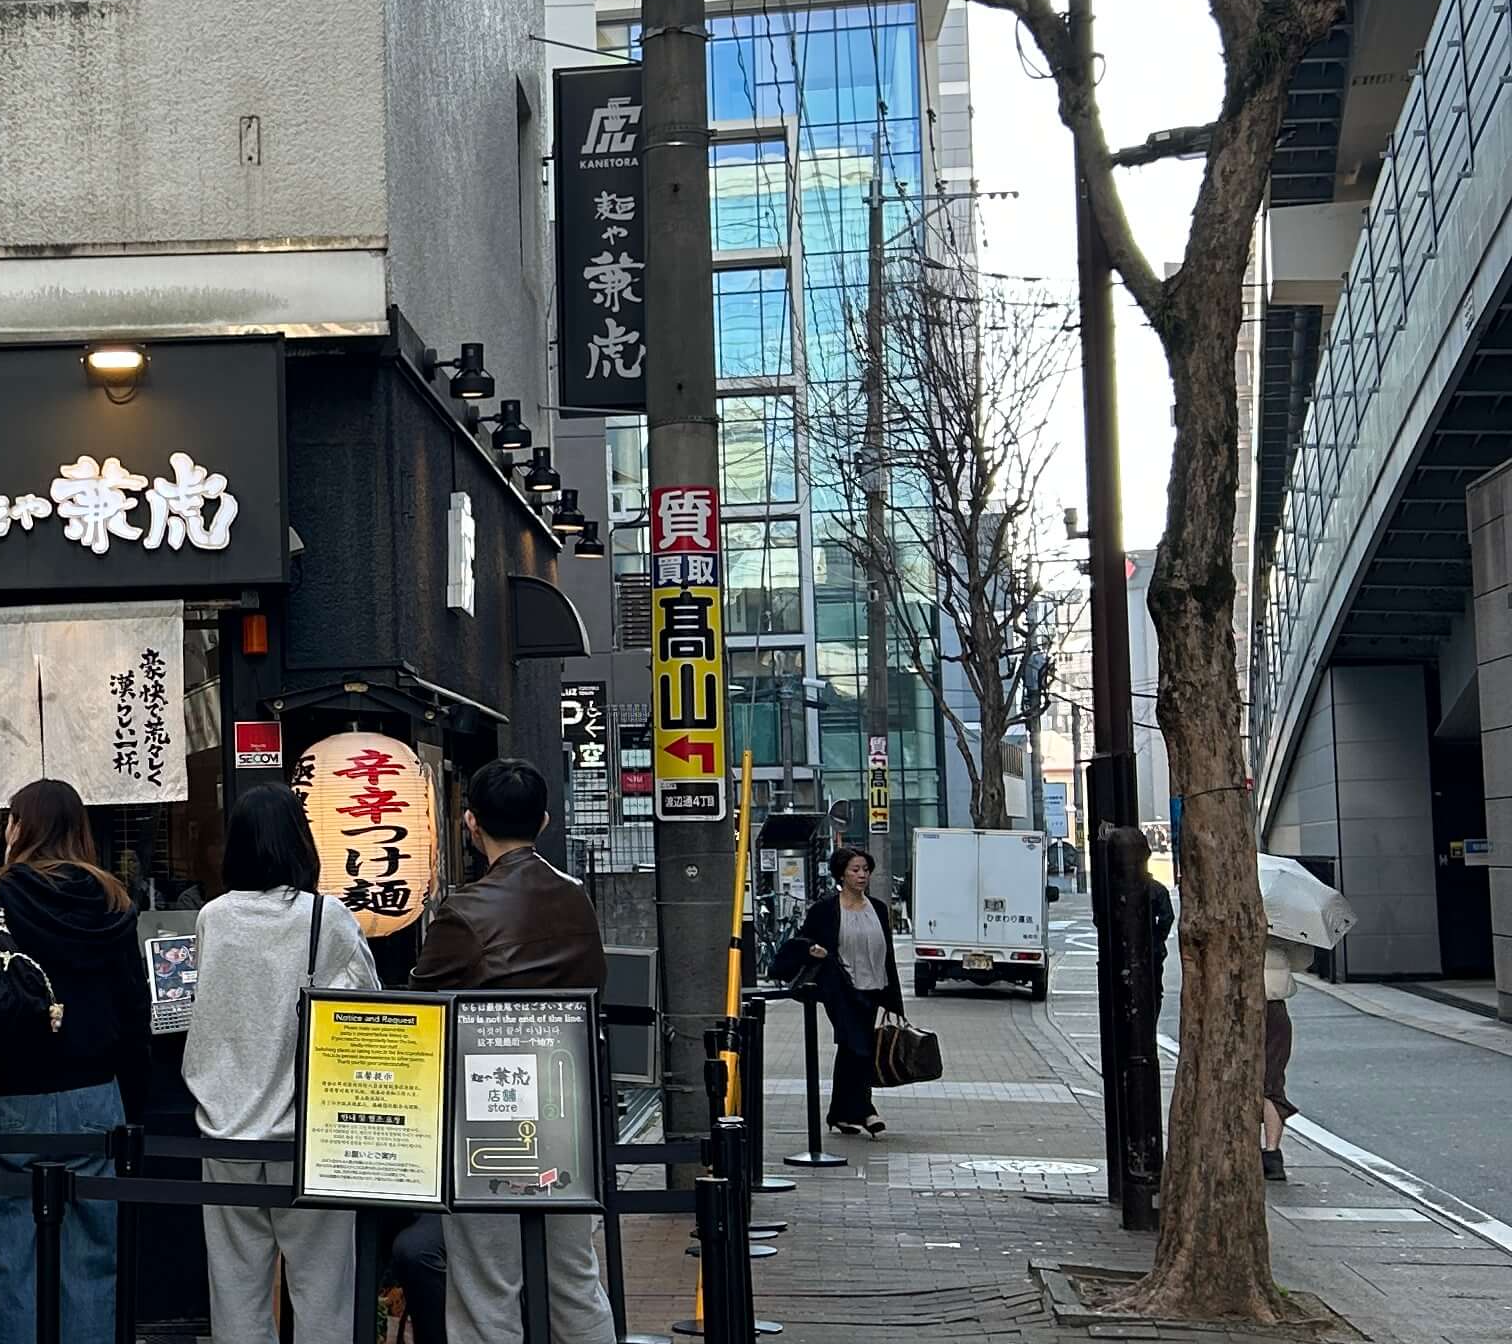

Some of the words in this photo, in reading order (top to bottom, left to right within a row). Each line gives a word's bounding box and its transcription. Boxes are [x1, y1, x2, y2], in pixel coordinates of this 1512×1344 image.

[579, 157, 639, 169] KANETORA
[658, 490, 712, 549] 質
[658, 556, 714, 586] 買取
[110, 670, 141, 779] 漢らしい一杯。
[139, 648, 171, 787] 豪快で荒々しく
[561, 700, 584, 739] P
[239, 753, 279, 763] SECOM
[580, 742, 605, 767] 空
[334, 748, 412, 917] 辛辛つけ麺
[336, 1014, 362, 1023] Notice
[382, 1016, 415, 1025] Request
[488, 1103, 518, 1113] store
